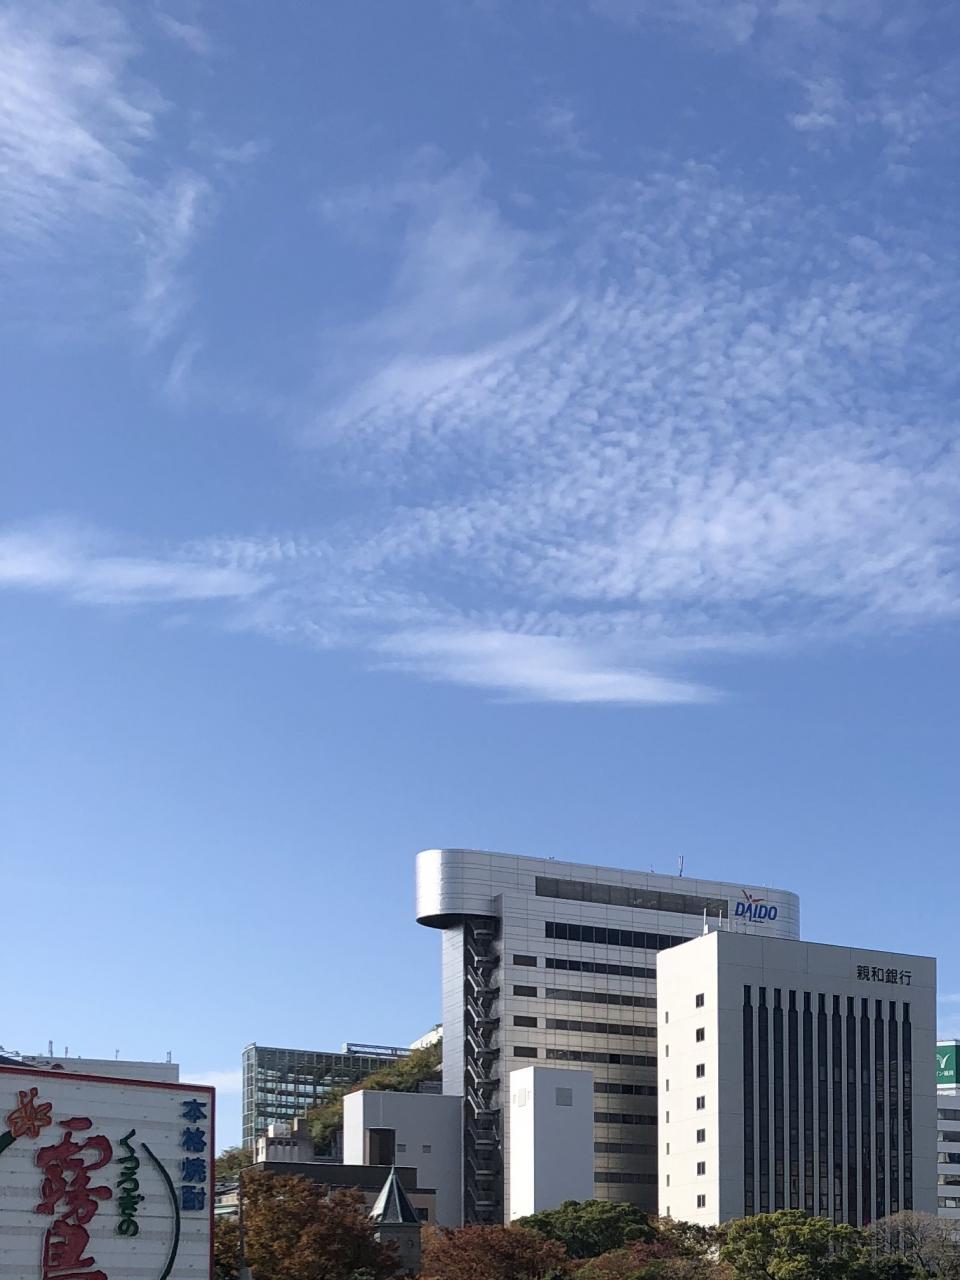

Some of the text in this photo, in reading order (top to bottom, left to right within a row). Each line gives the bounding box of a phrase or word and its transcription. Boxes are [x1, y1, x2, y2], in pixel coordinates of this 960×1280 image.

[734, 901, 778, 922] DAIDO
[856, 964, 913, 987] 親和銀行
[117, 1129, 144, 1236] くつろぎの
[182, 1099, 207, 1210] 本格焼酎
